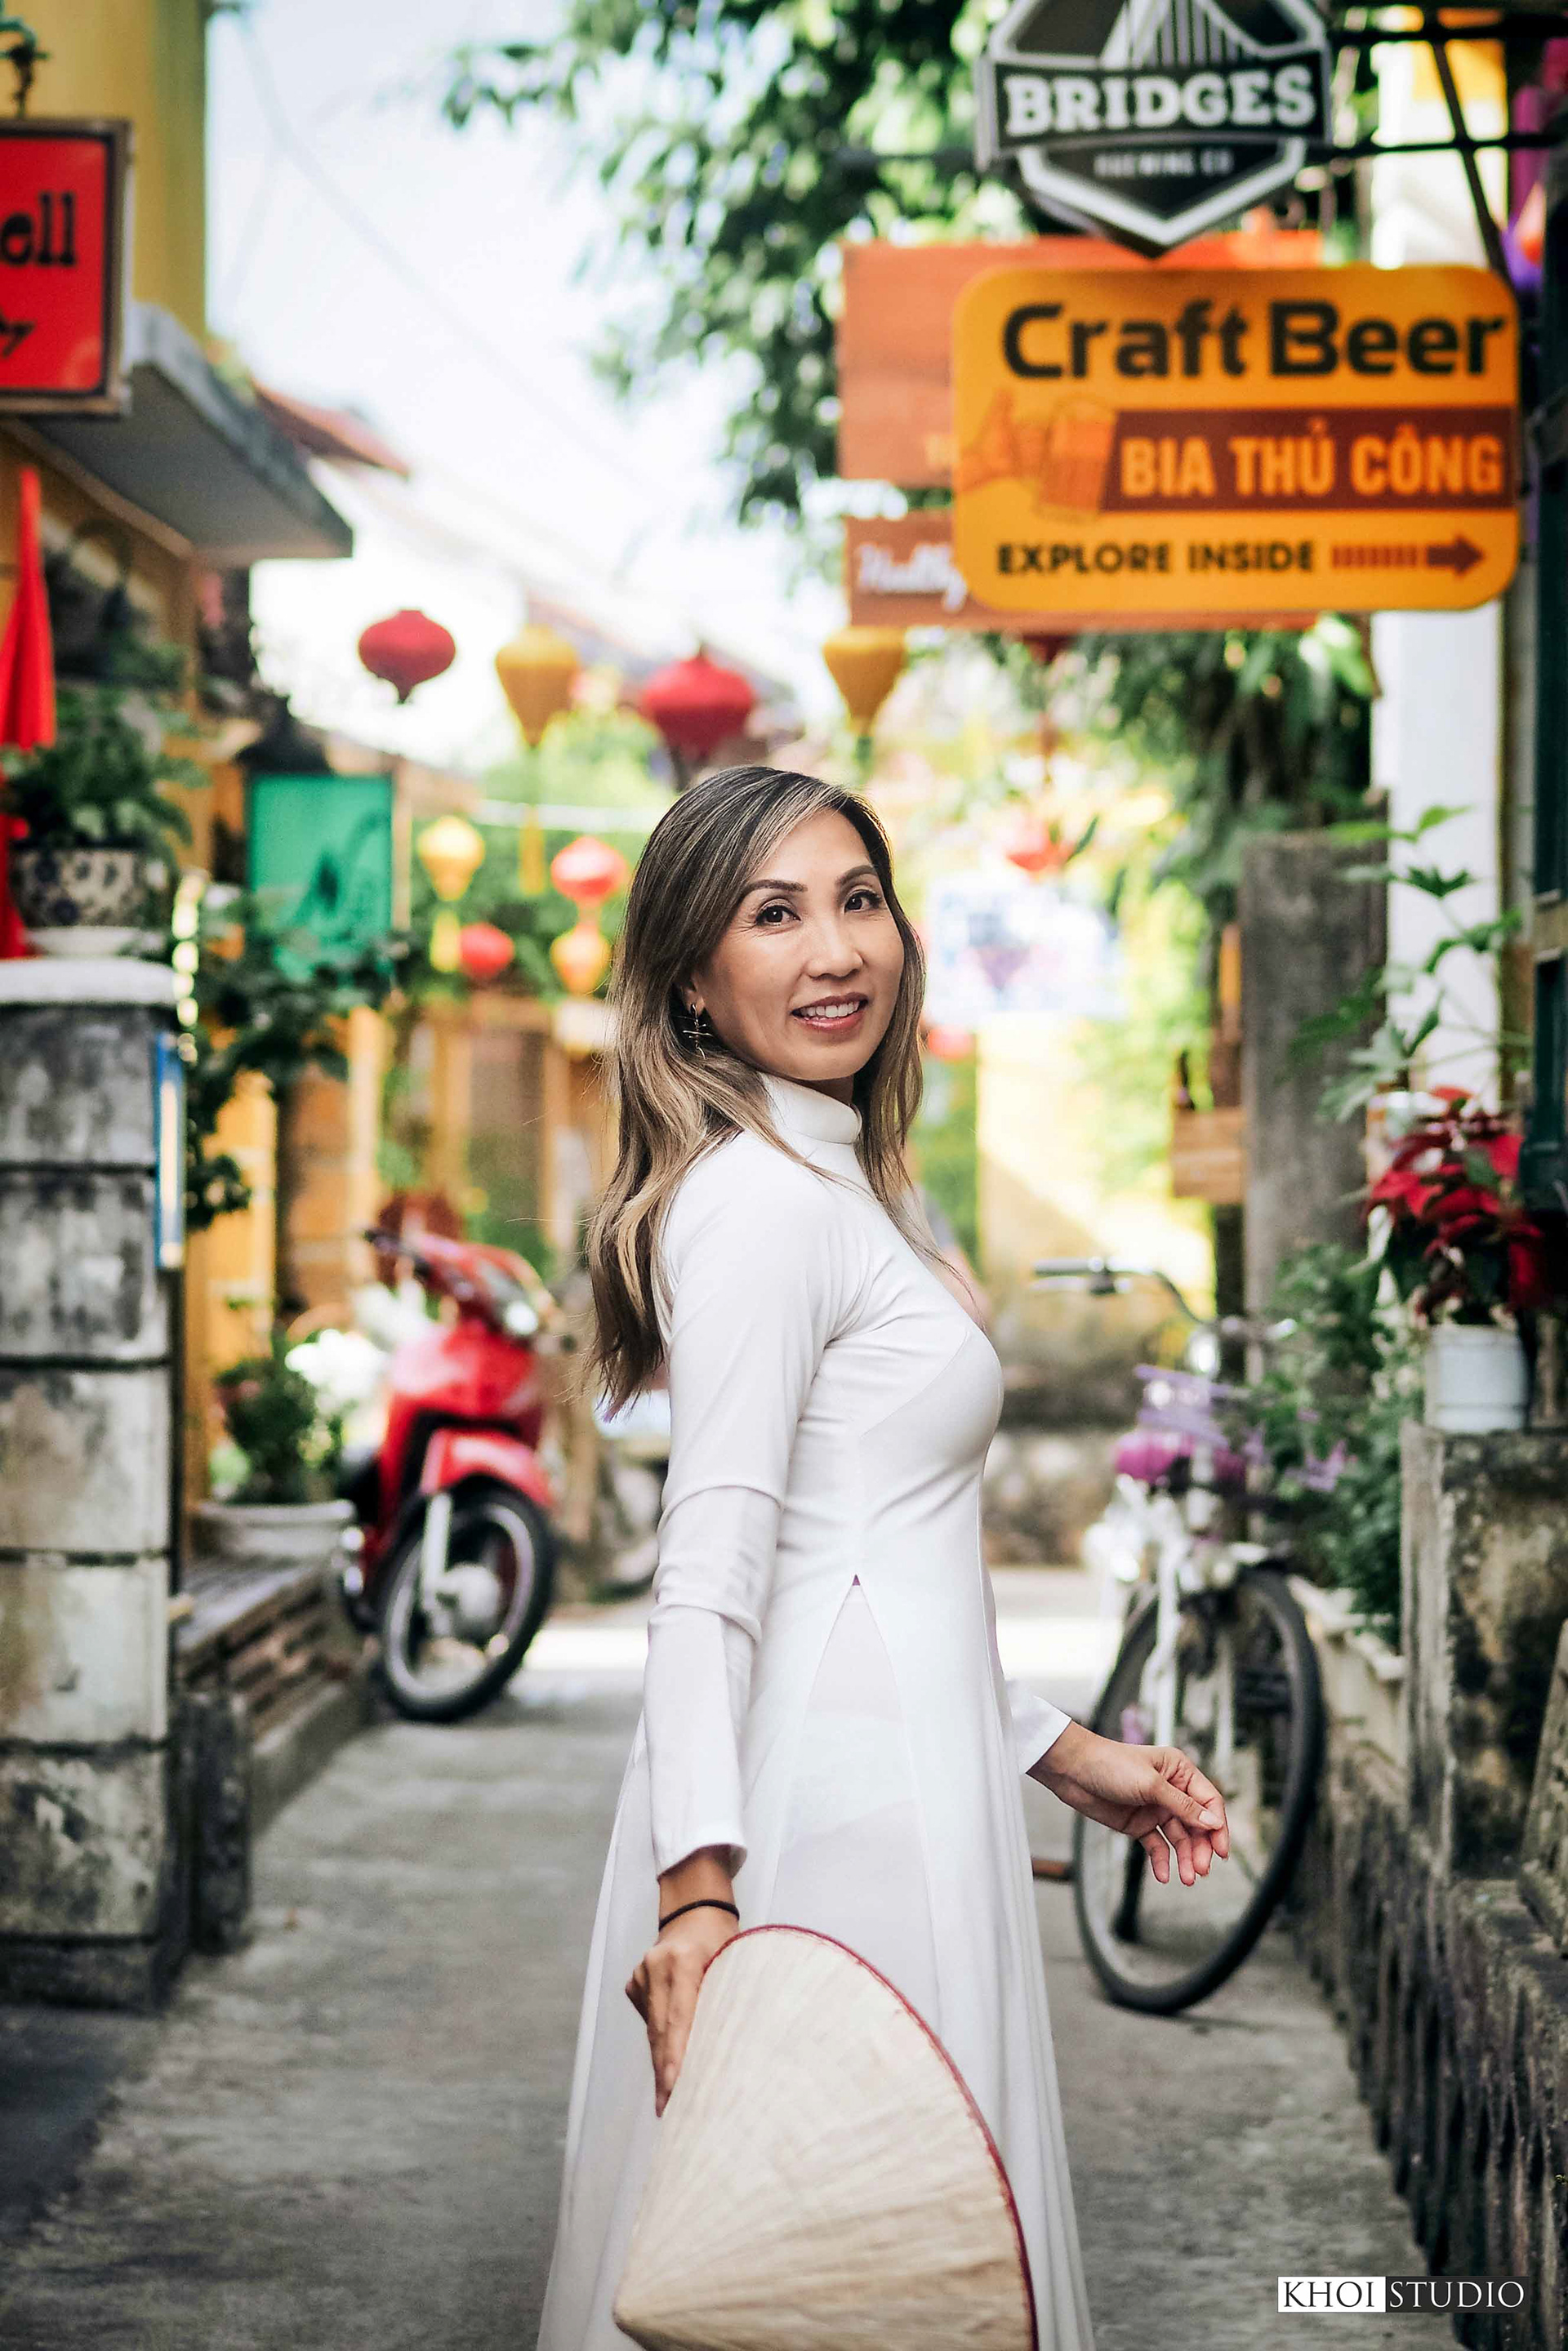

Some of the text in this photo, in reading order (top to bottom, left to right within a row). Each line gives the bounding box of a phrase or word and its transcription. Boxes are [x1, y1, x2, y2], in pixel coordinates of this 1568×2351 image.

[1005, 69, 1316, 135] BRIDGES
[1004, 300, 1506, 379] Craft Beer
[1122, 416, 1502, 496] BIA THỦ CÔNG
[999, 540, 1312, 574] EXPLORE INSIDE
